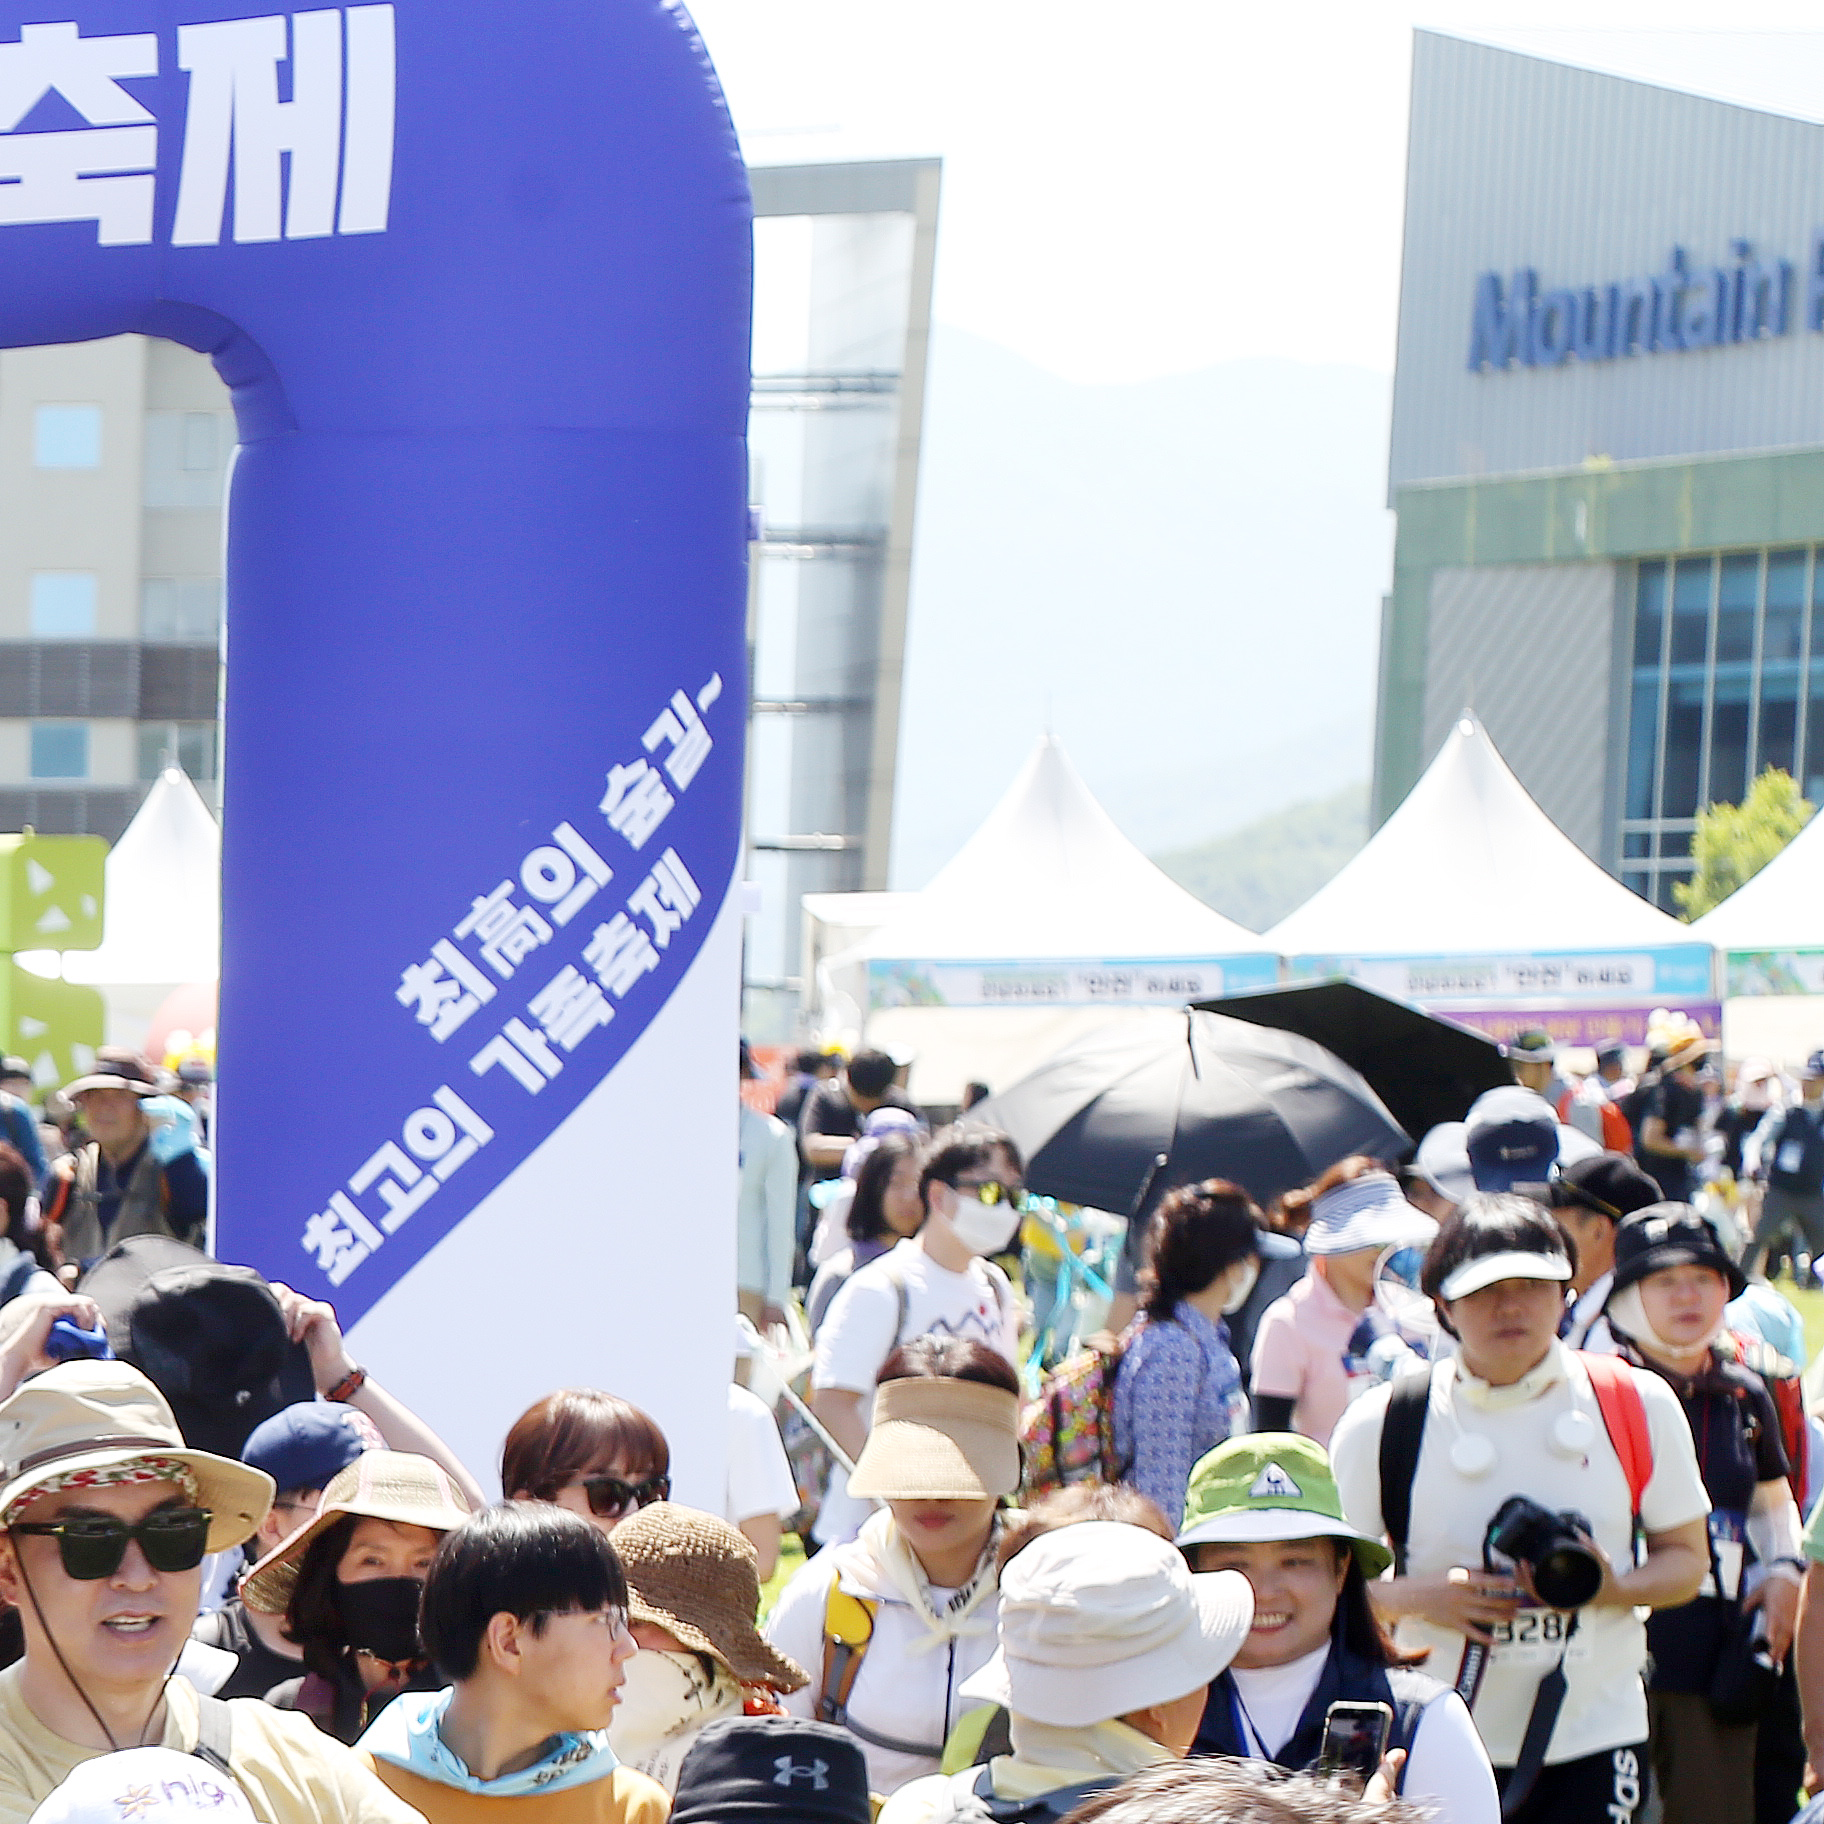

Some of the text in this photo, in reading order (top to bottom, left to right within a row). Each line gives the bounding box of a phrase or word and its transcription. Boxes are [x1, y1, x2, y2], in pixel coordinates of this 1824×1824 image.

[1468, 236, 1793, 376] Mountain
[301, 847, 702, 1287] 최고의 가족축제
